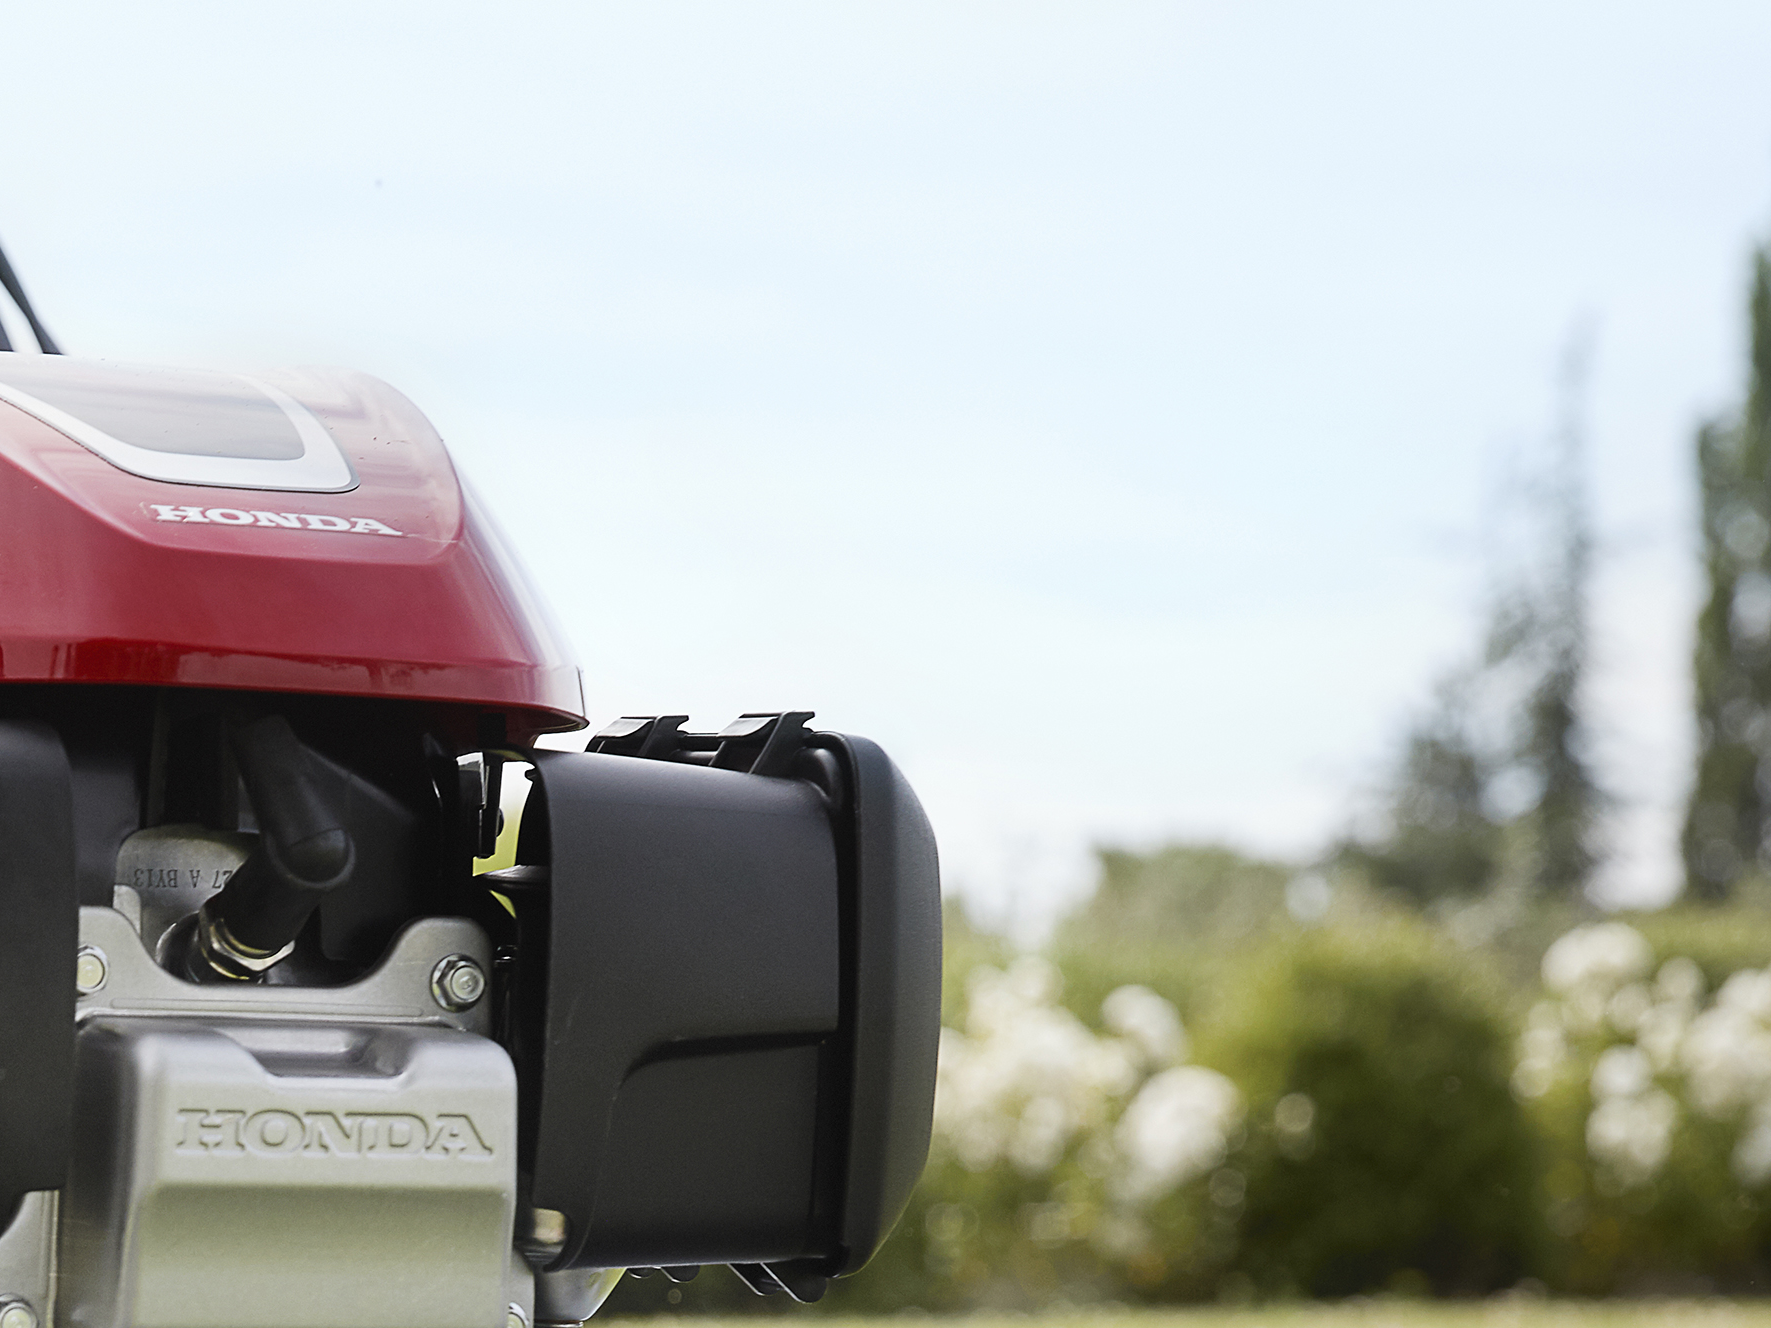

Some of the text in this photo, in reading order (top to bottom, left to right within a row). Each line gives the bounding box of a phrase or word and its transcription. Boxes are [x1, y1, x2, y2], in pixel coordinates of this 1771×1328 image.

[150, 504, 403, 536] HONDA
[132, 868, 179, 889] BY13
[189, 869, 201, 889] A
[176, 1109, 494, 1159] HONDA
